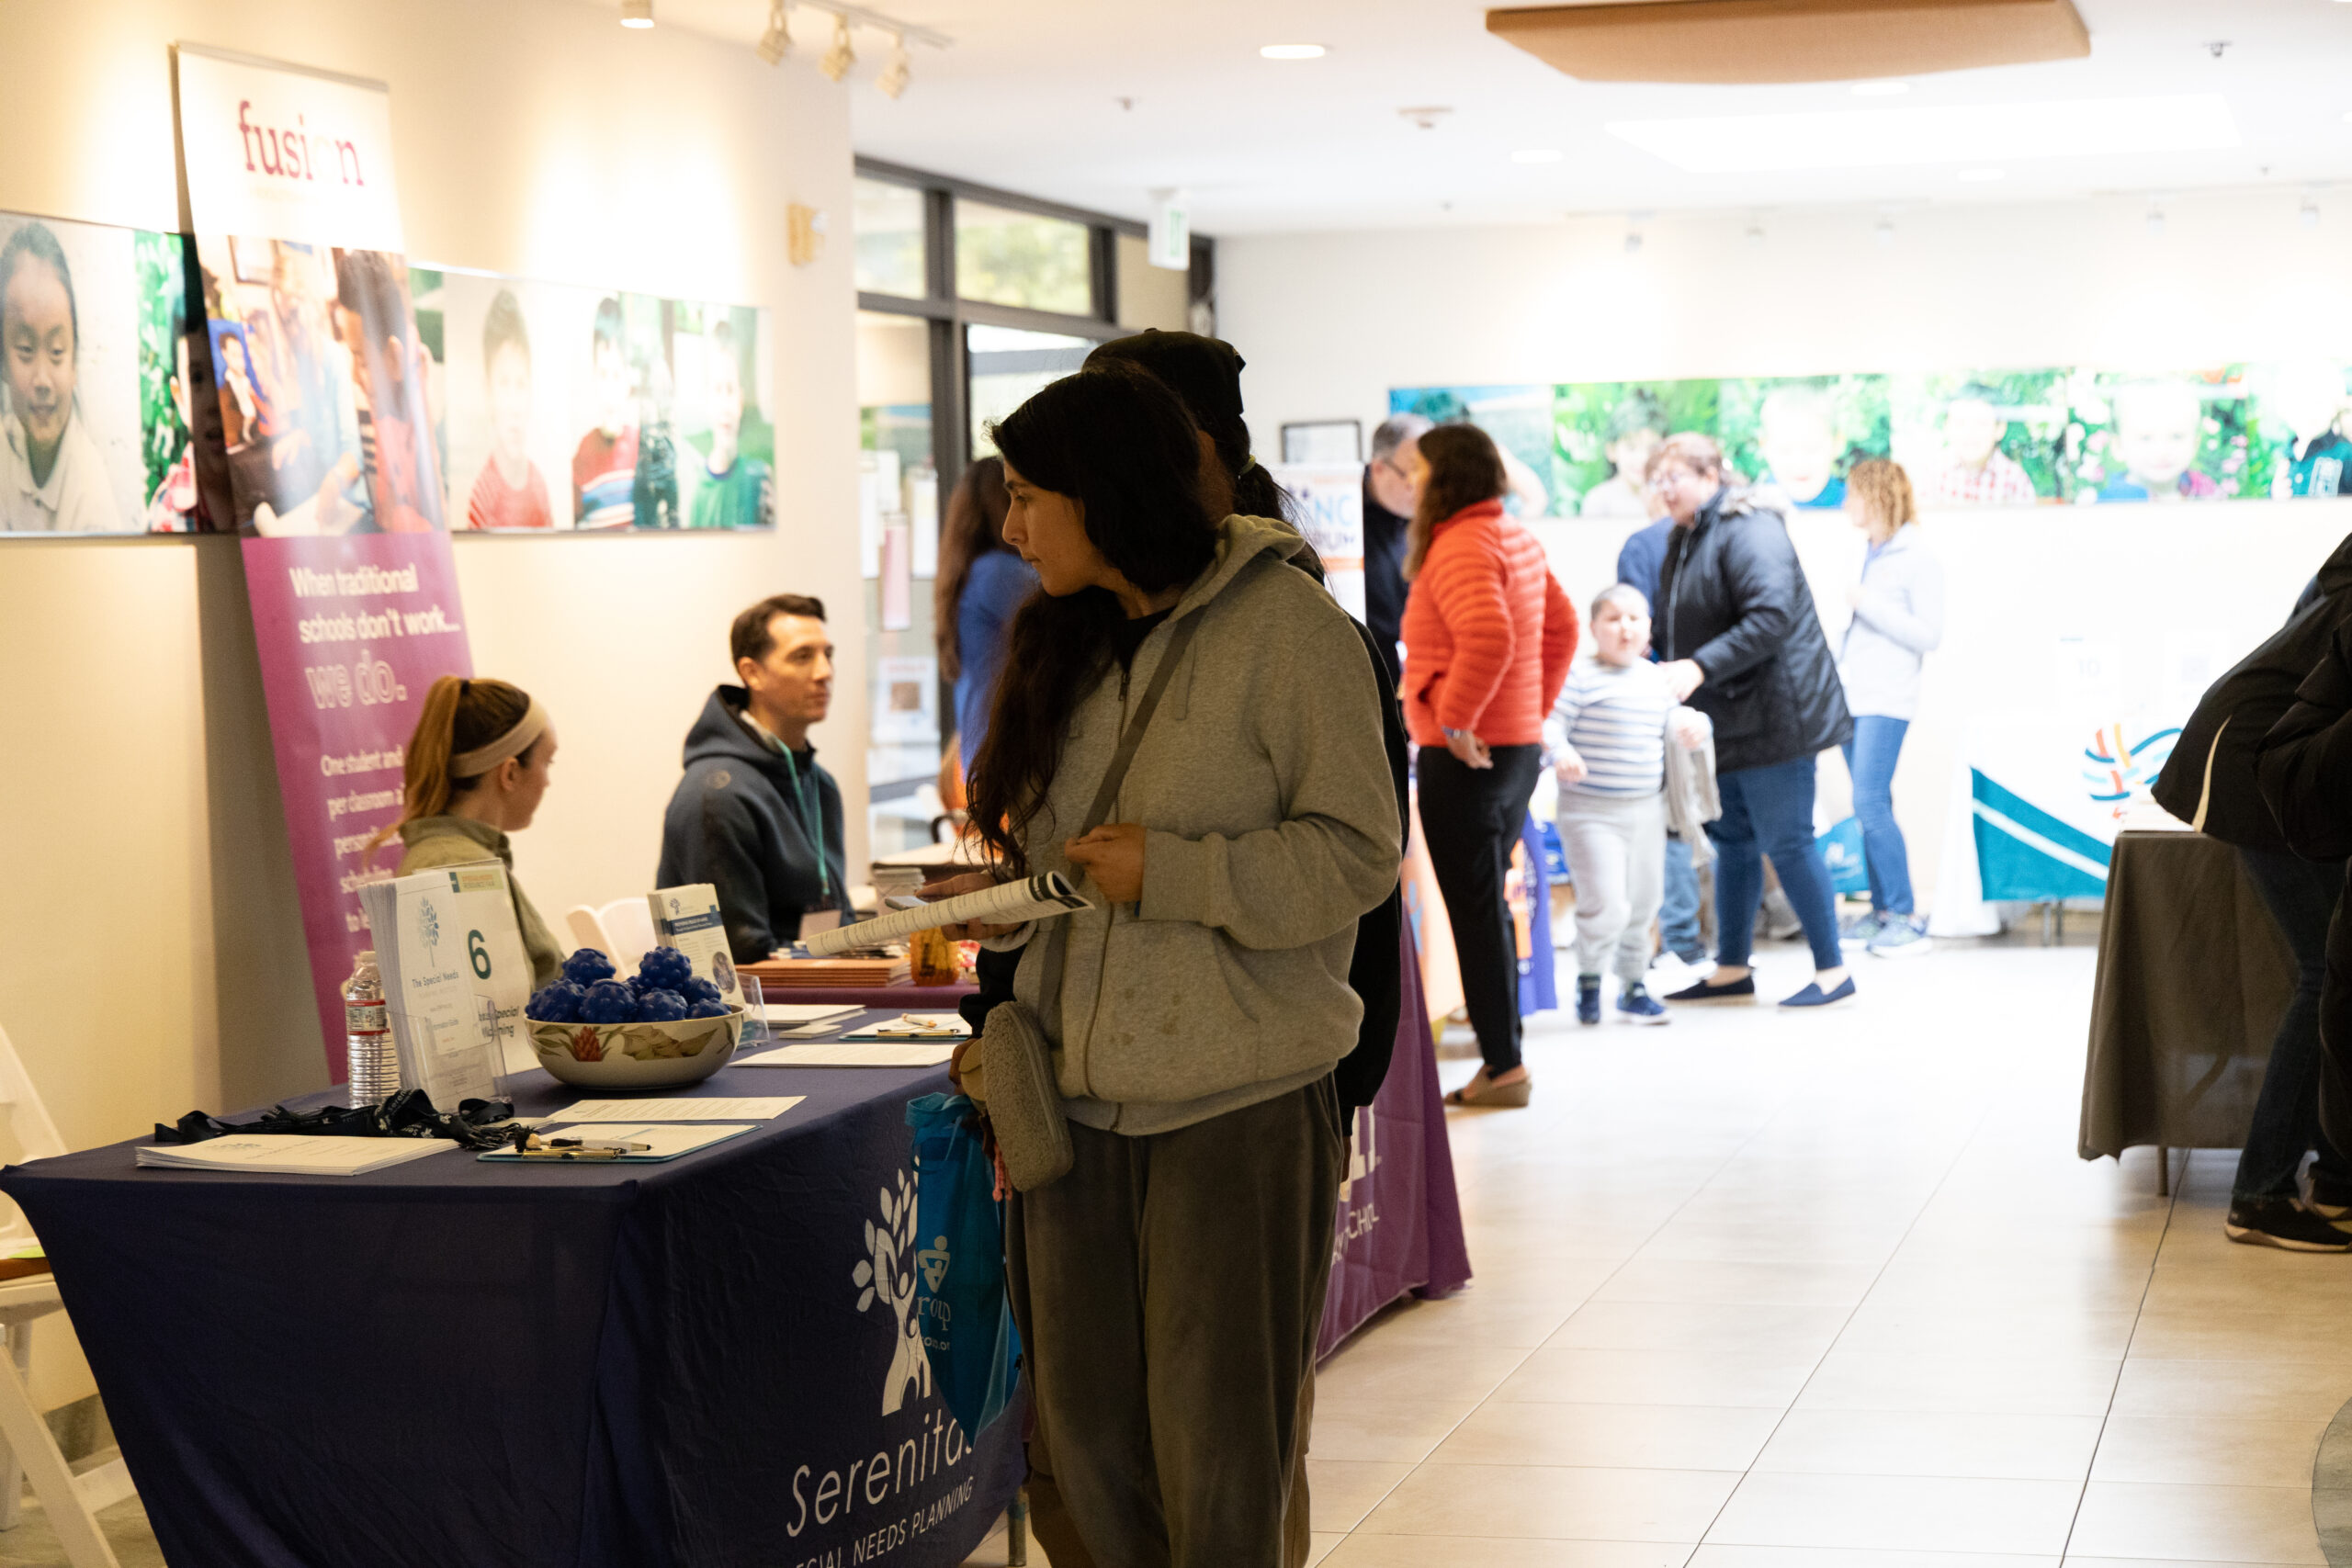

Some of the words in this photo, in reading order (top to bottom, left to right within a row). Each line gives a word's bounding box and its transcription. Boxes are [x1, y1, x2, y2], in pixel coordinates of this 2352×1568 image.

[238, 100, 364, 186] fusin
[335, 561, 419, 596] traditional
[299, 611, 356, 644] schools
[356, 606, 403, 640] don't
[304, 664, 353, 710] we
[468, 929, 492, 980] 6
[917, 1295, 952, 1332] roup
[786, 1408, 972, 1538] Serenita
[853, 1517, 908, 1566] NEEDS
[910, 1475, 974, 1539] PLANNING
